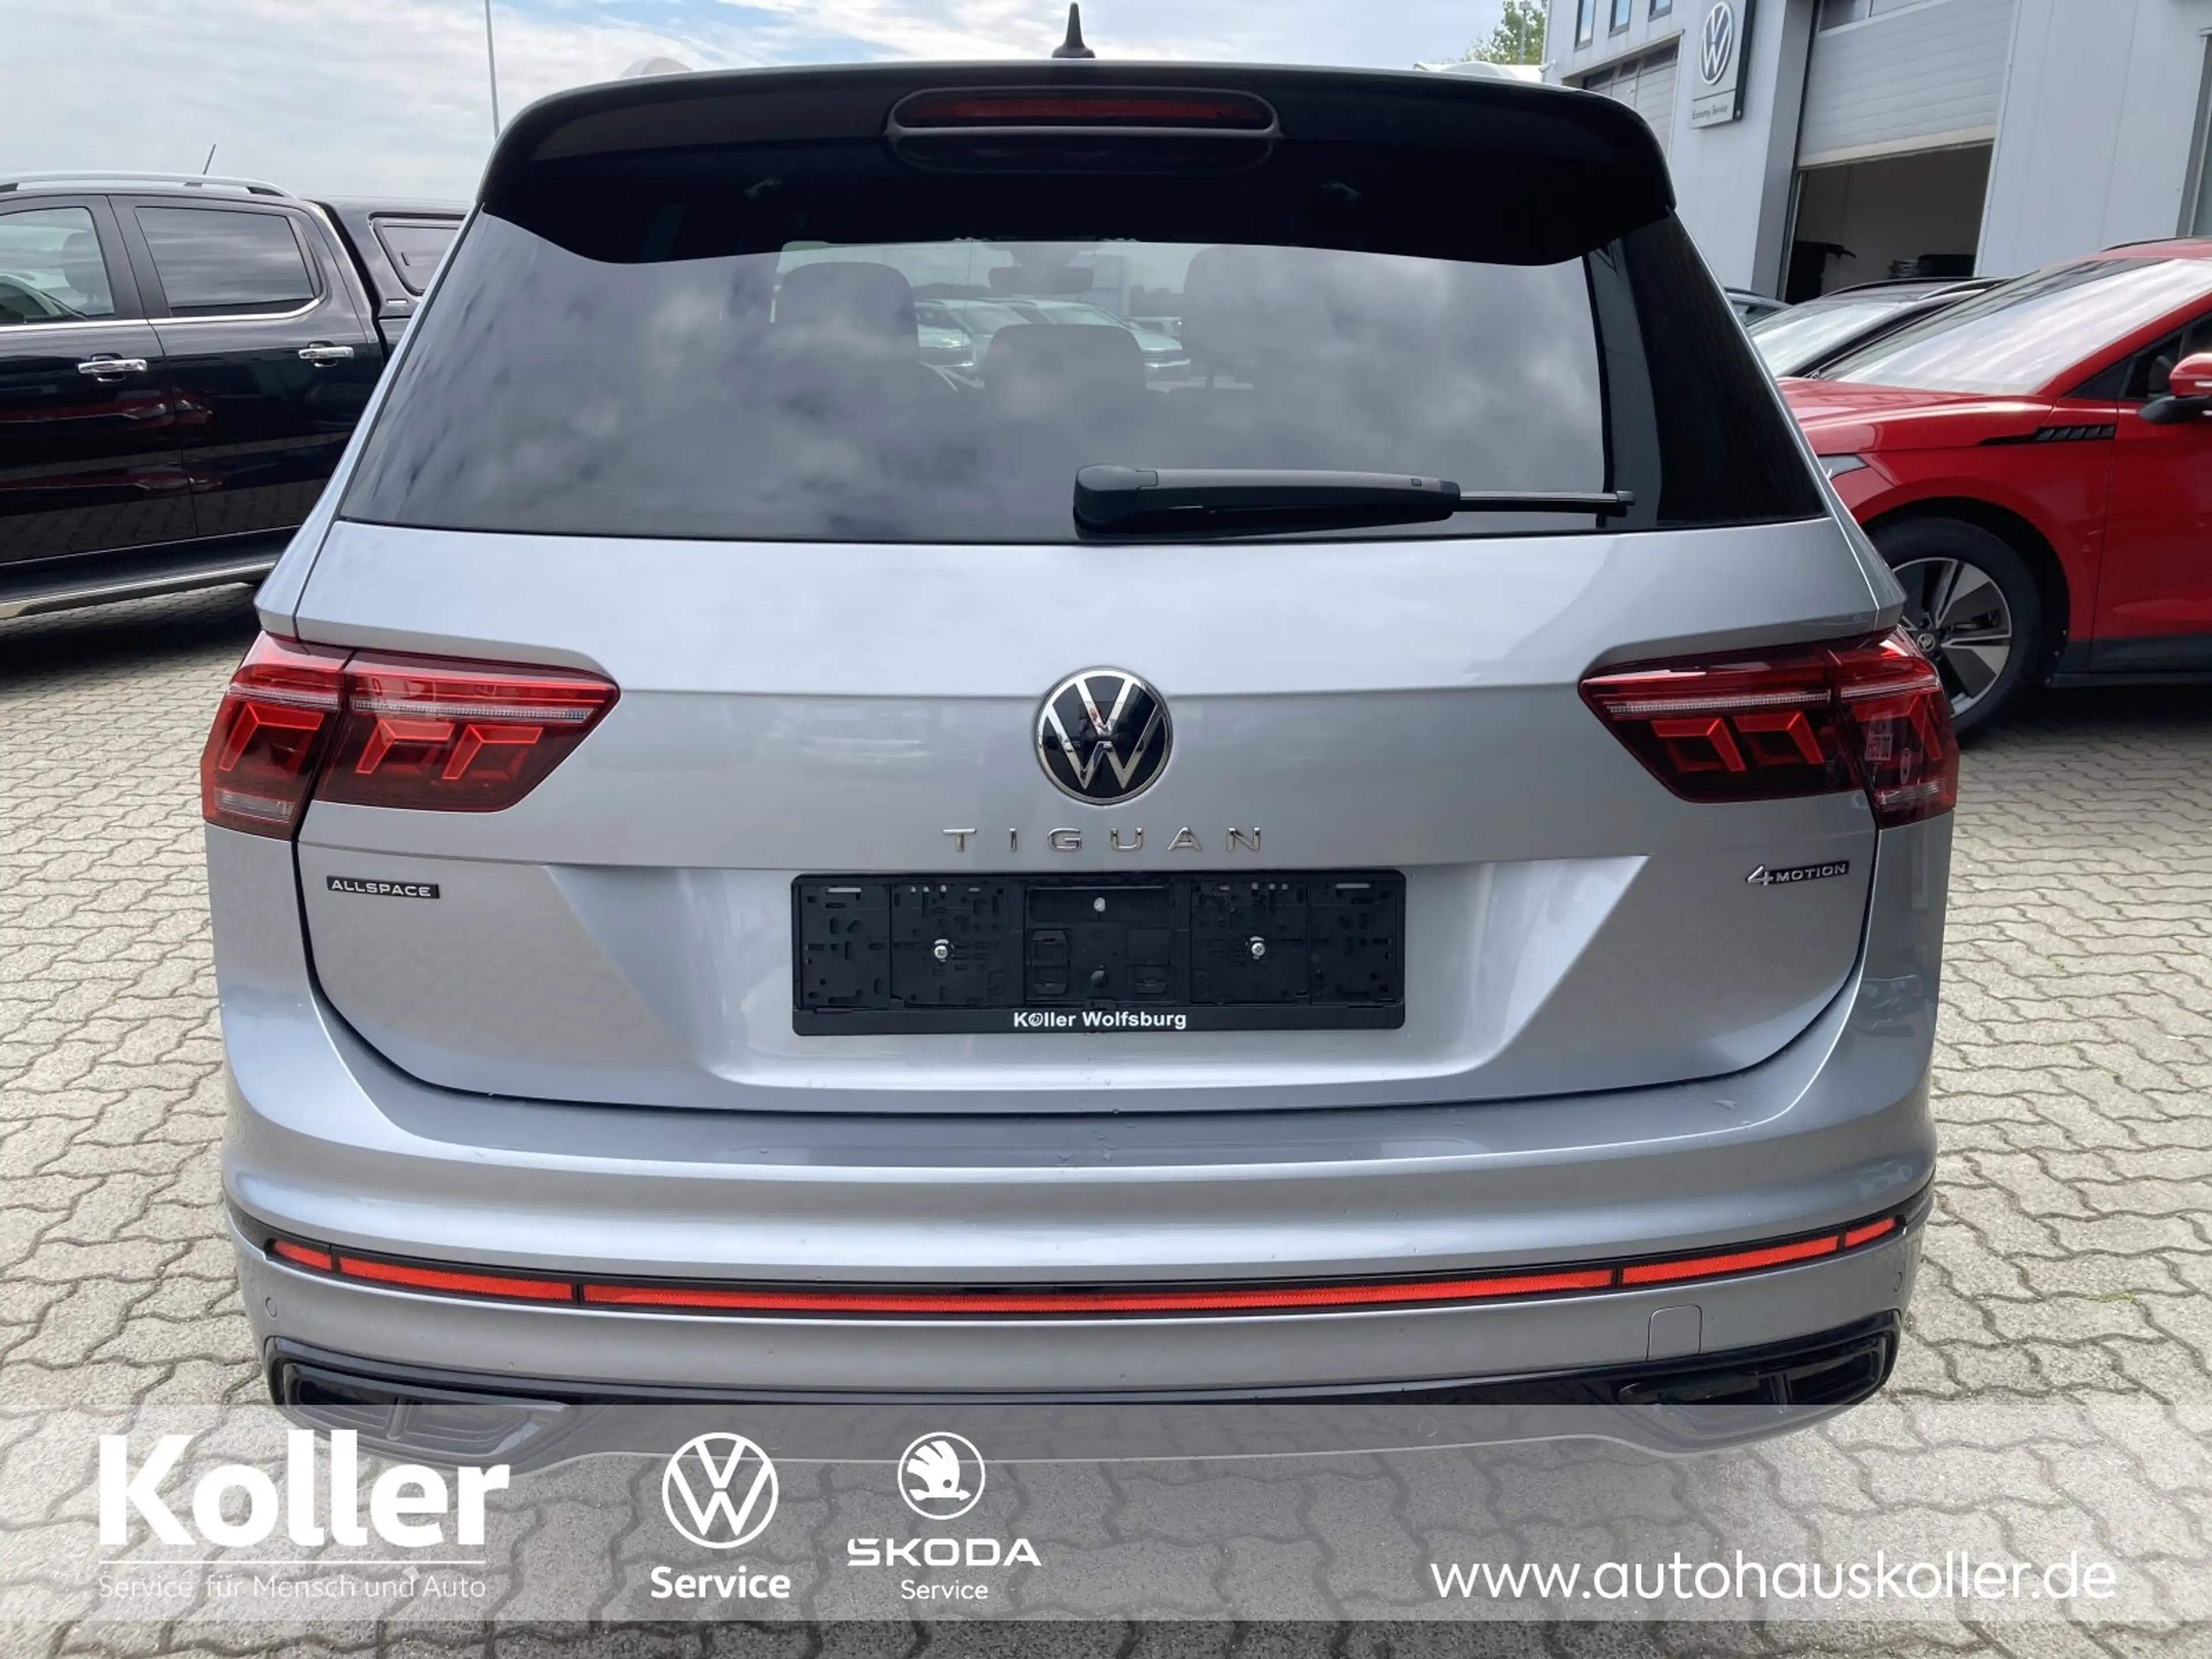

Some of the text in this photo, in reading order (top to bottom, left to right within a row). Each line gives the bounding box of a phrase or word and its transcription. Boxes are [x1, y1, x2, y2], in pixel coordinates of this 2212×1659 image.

[942, 827, 1260, 853] TIGUAN
[331, 879, 431, 897] ALLSPACE
[1082, 1012, 1187, 1029] Wolfsburg
